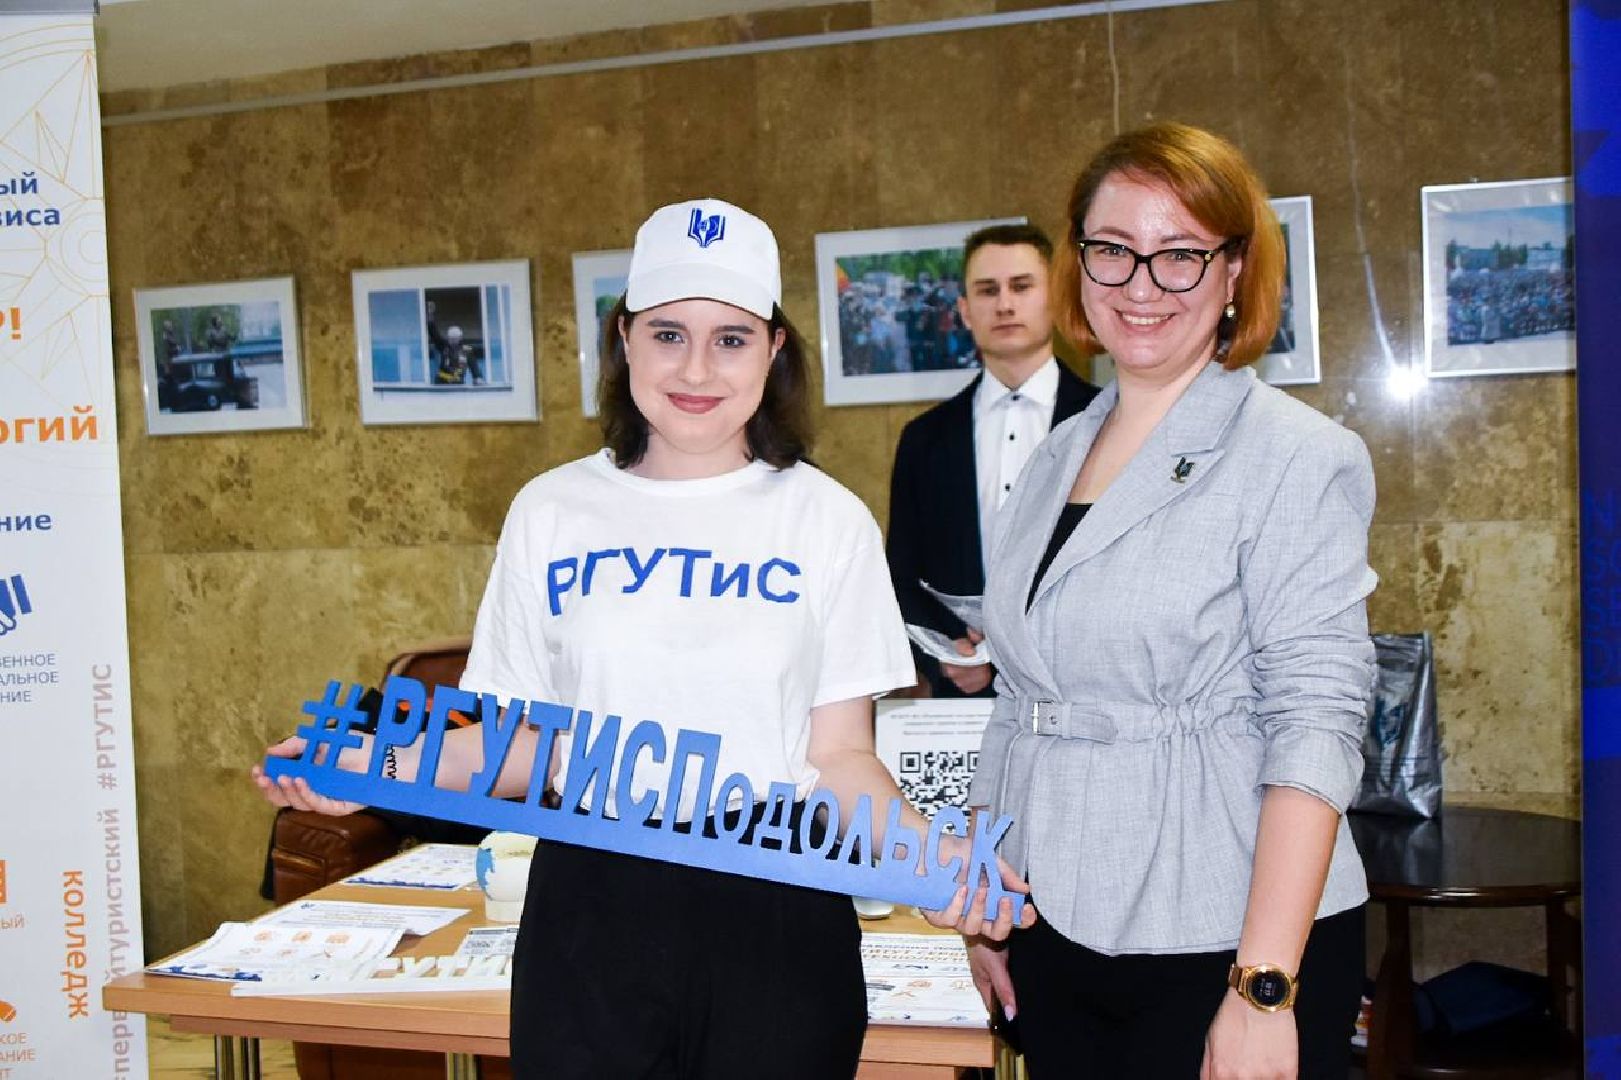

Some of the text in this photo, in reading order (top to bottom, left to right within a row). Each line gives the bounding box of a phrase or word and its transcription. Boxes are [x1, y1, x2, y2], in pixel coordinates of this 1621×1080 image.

[0, 208, 61, 226] иса
[0, 514, 52, 531] ние
[0, 653, 56, 669] ЕННОЕ
[92, 663, 118, 791] #РГУТИС
[61, 870, 89, 1019] колледж
